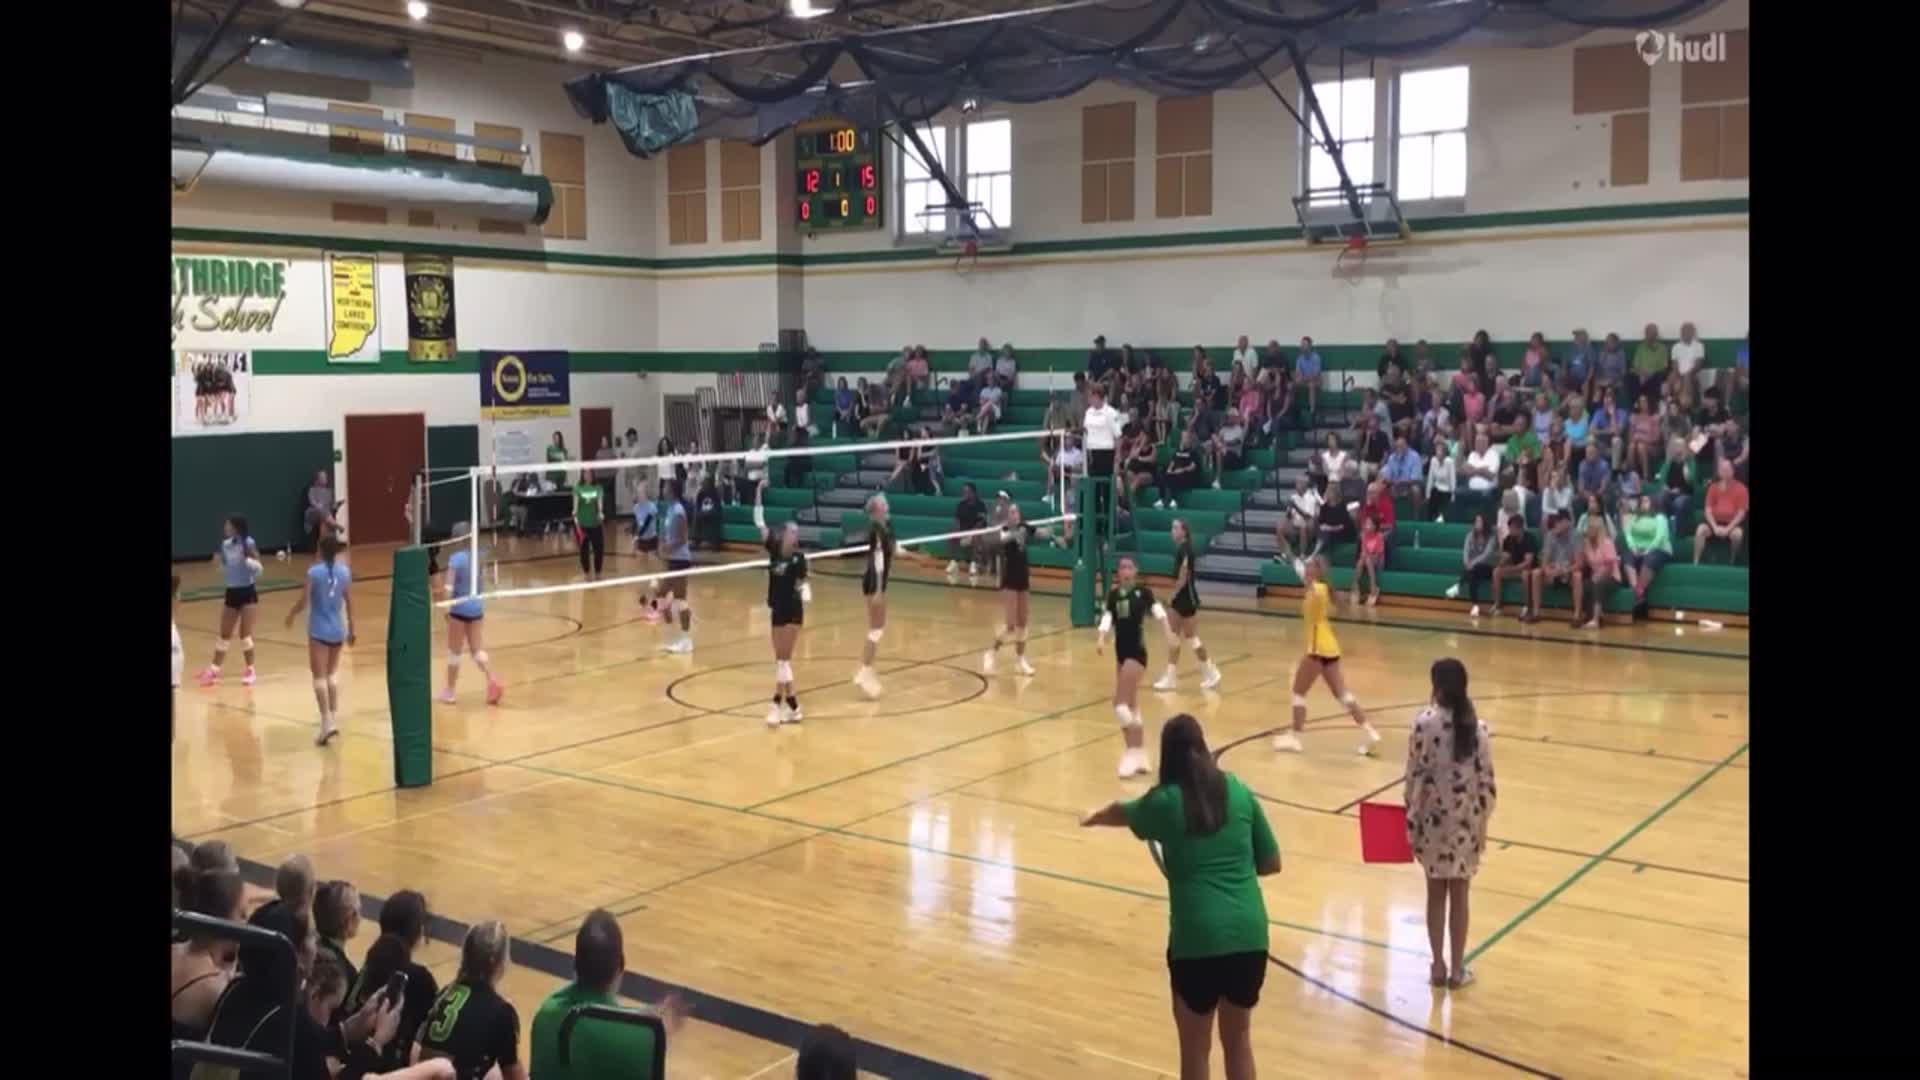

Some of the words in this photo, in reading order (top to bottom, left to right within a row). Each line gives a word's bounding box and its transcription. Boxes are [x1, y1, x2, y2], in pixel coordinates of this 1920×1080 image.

[806, 170, 820, 192] 12
[862, 166, 875, 188] 15
[801, 201, 810, 219] 0
[866, 196, 875, 214] 0
[191, 289, 287, 333] School
[430, 984, 470, 1041] 3
